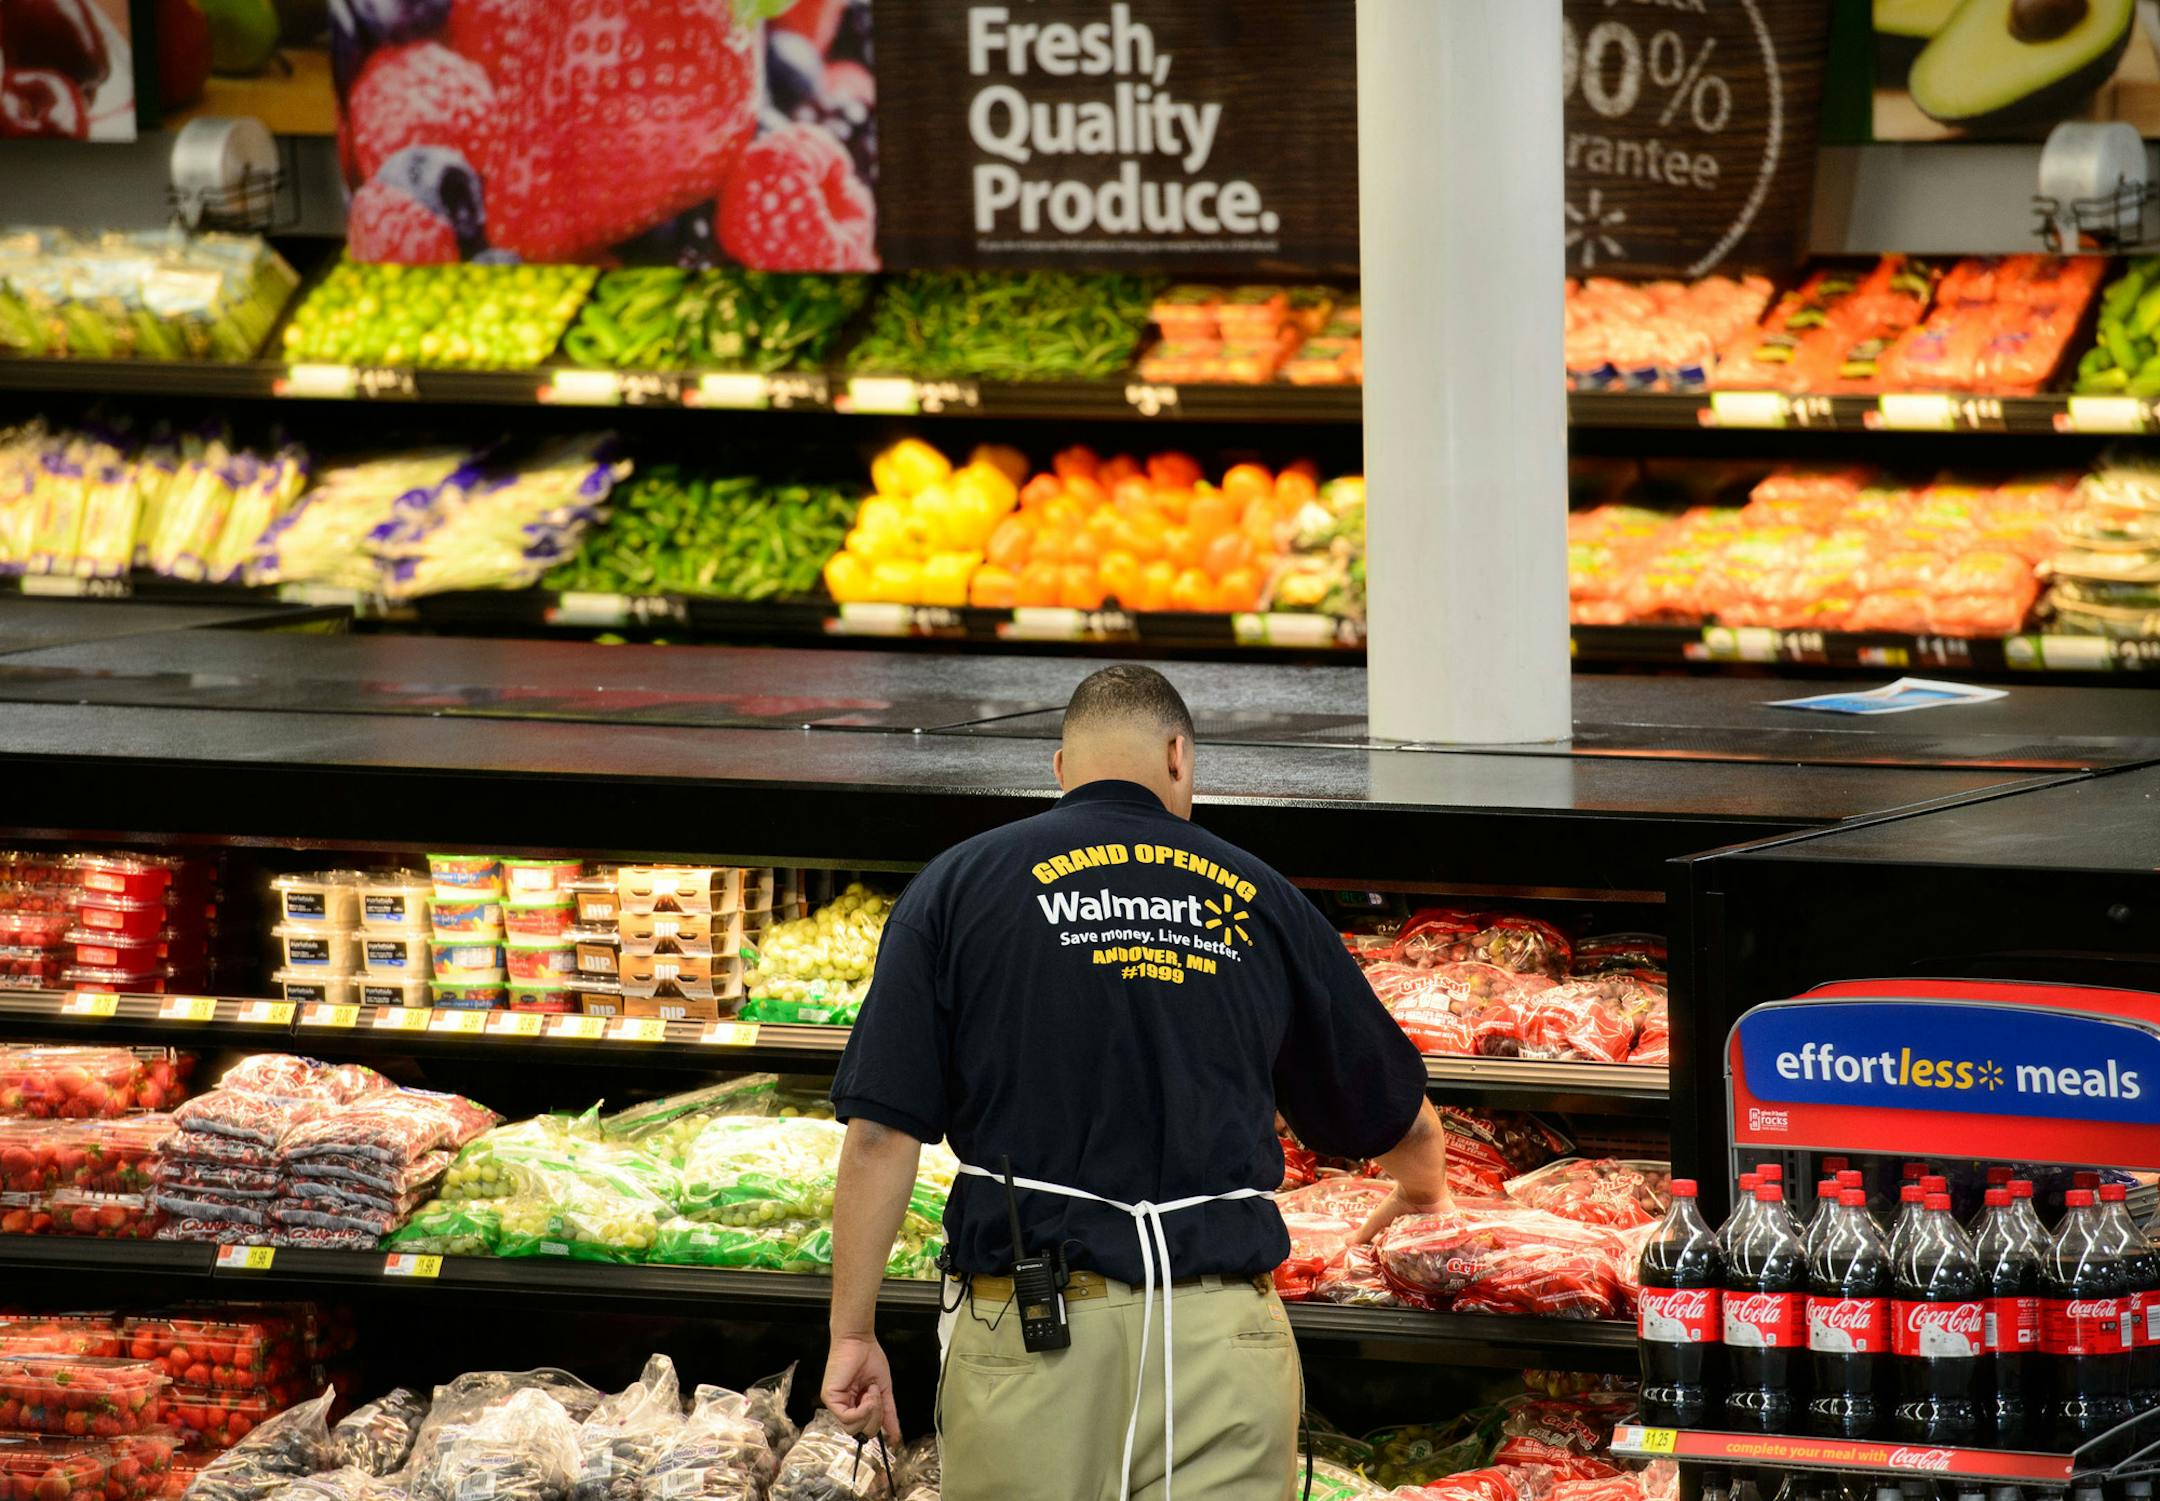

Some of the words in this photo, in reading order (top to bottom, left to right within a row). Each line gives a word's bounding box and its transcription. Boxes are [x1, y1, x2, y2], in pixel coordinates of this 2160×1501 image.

[967, 3, 1172, 86] Fresh,
[967, 82, 1223, 174] Quality
[973, 161, 1281, 234] Produce.
[1032, 844, 1129, 885] GRAND
[1134, 844, 1258, 904] OPENING
[586, 904, 613, 919] DIP
[1037, 888, 1203, 928] Walmart
[654, 922, 680, 937] DIP
[1060, 931, 1098, 947] Save
[1101, 929, 1155, 943] money.
[1159, 928, 1191, 947] Live
[1194, 934, 1242, 962] better.
[584, 955, 611, 970] DIP
[654, 964, 680, 980] DIP
[1092, 946, 1183, 968] ANDOVER,
[1186, 954, 1217, 975] MN
[1121, 965, 1185, 985] #1999
[1776, 1042, 1974, 1090] effortless
[2016, 1060, 2141, 1100] meals
[1761, 1116, 1788, 1126] racks
[1638, 1287, 1710, 1319] Coca-Cola
[2066, 1299, 2118, 1318] Coca-Cola
[1907, 1303, 1984, 1333] Coca-Cola
[1646, 1432, 1670, 1447] $1.25
[1726, 1442, 1787, 1457] complete
[1789, 1447, 1820, 1460] your
[1822, 1448, 1856, 1460] meal
[1858, 1450, 1887, 1462] with
[1888, 1446, 1956, 1471] Coca-Cola
